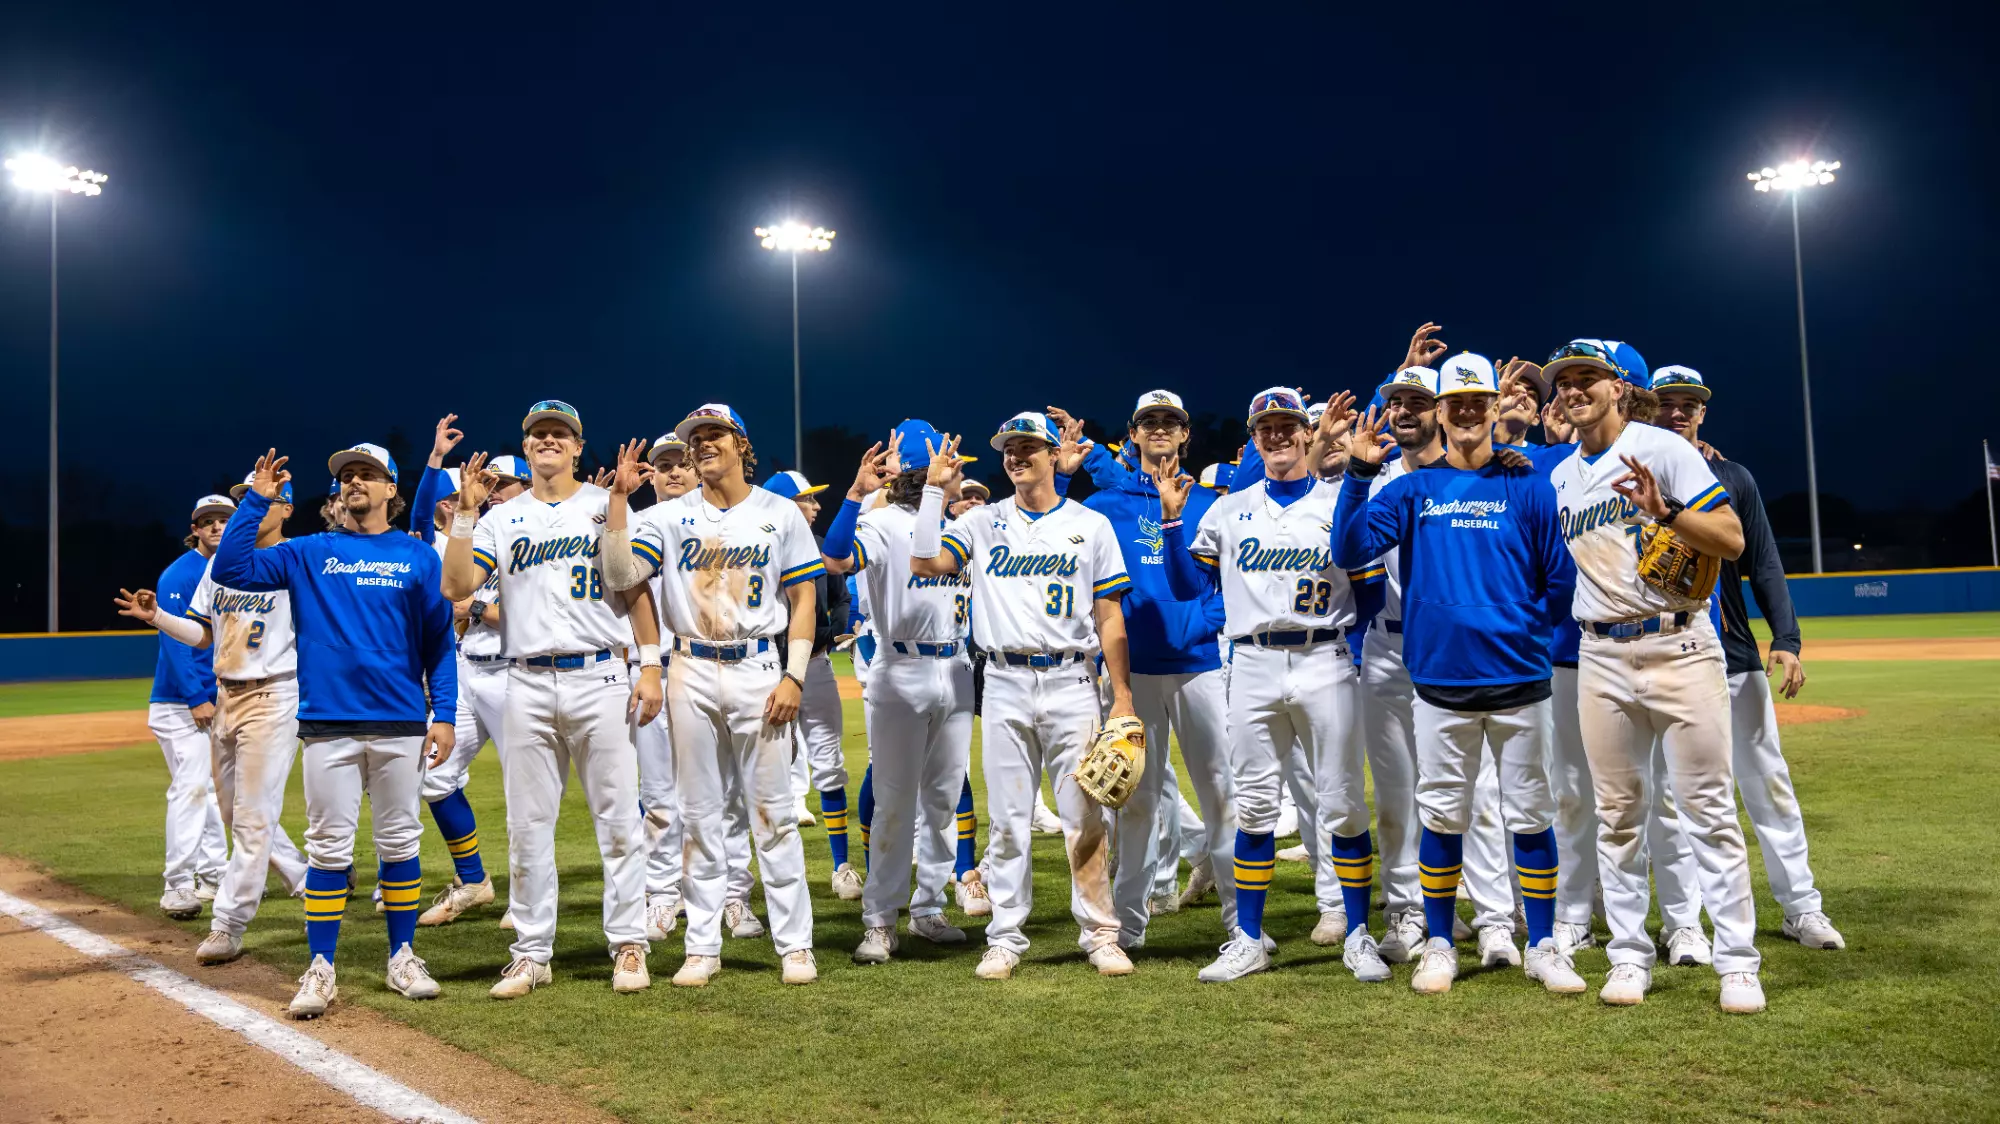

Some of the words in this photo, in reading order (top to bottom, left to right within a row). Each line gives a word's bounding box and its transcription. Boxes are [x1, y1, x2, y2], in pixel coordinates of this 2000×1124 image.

[1419, 498, 1507, 518] Roadrunners
[1451, 518, 1499, 530] BASEBALL
[1560, 493, 1640, 546] Runners
[508, 534, 602, 575] Runners
[677, 537, 771, 572] Runners
[1236, 536, 1332, 572] Runners
[1624, 523, 1645, 561] 7
[322, 557, 412, 576] Roadrunners
[985, 544, 1079, 578] Runners
[356, 577, 404, 589] BASEBALL
[570, 564, 604, 602] 38
[746, 574, 765, 610] 3
[1044, 581, 1075, 619] 31
[1294, 576, 1333, 618] 23
[212, 587, 277, 617] Runners
[247, 619, 266, 649] 2
